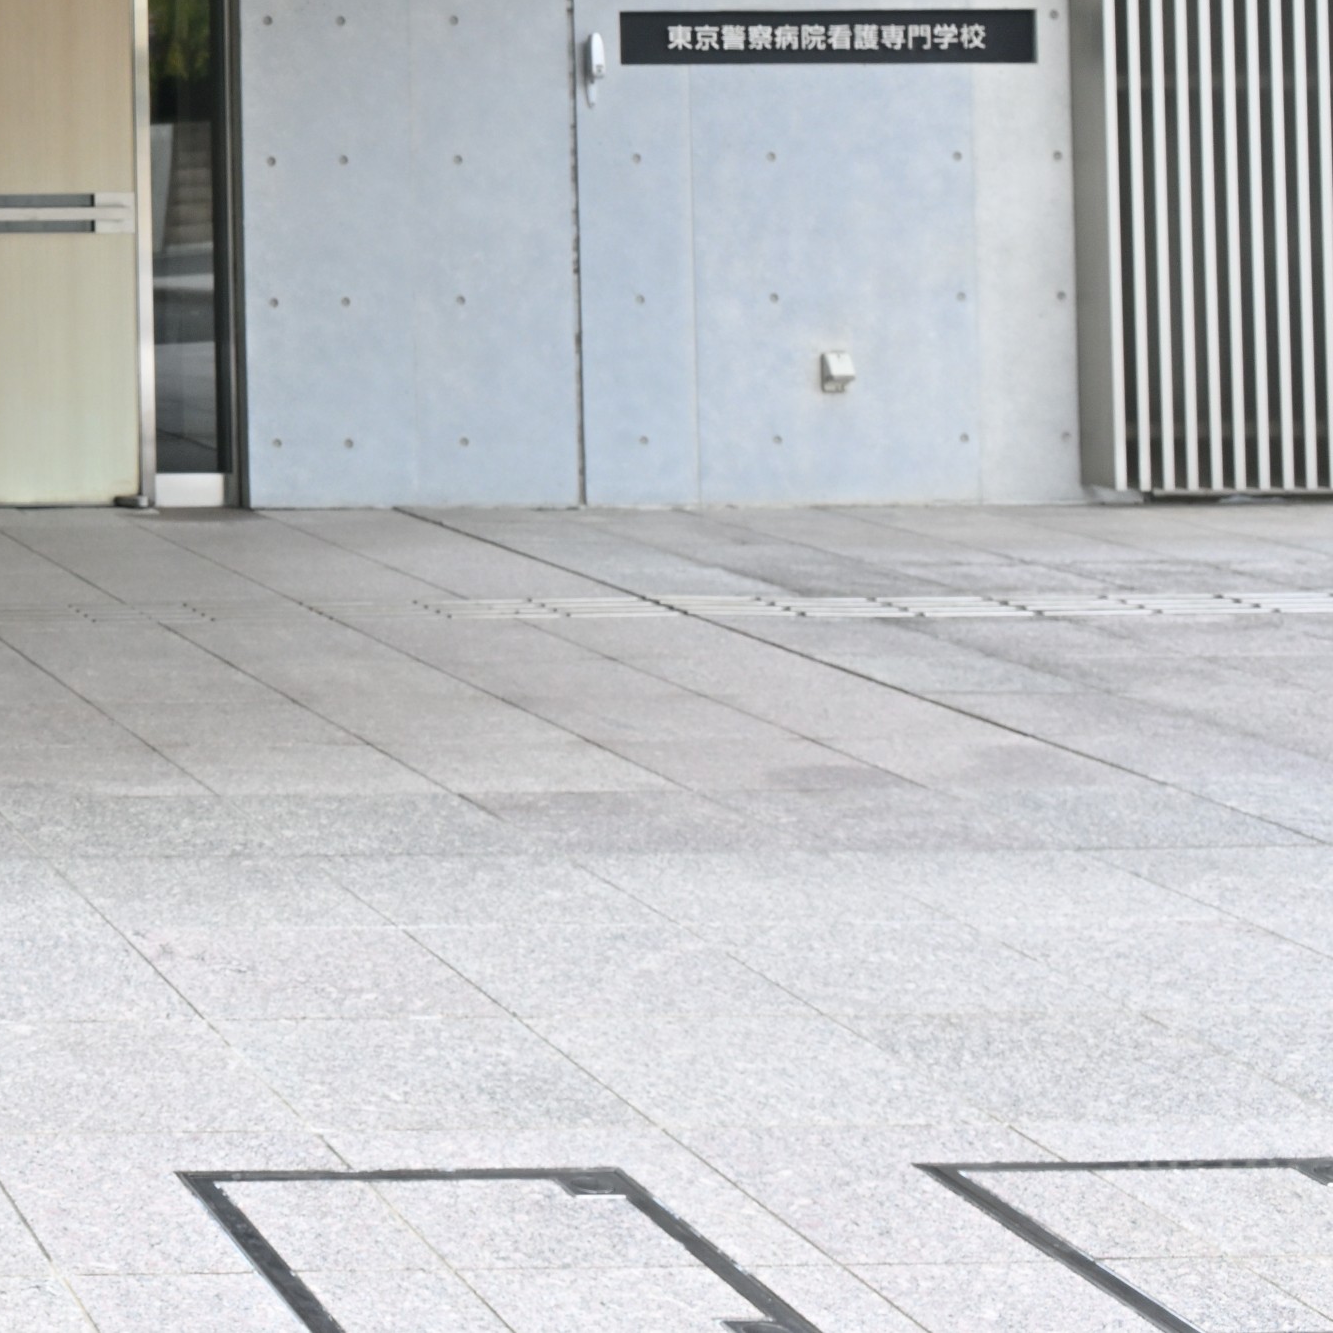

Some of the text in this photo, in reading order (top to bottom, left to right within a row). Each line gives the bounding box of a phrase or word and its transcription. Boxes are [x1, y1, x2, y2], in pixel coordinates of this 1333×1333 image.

[667, 23, 987, 51] 東京警察病院看護専門学校
